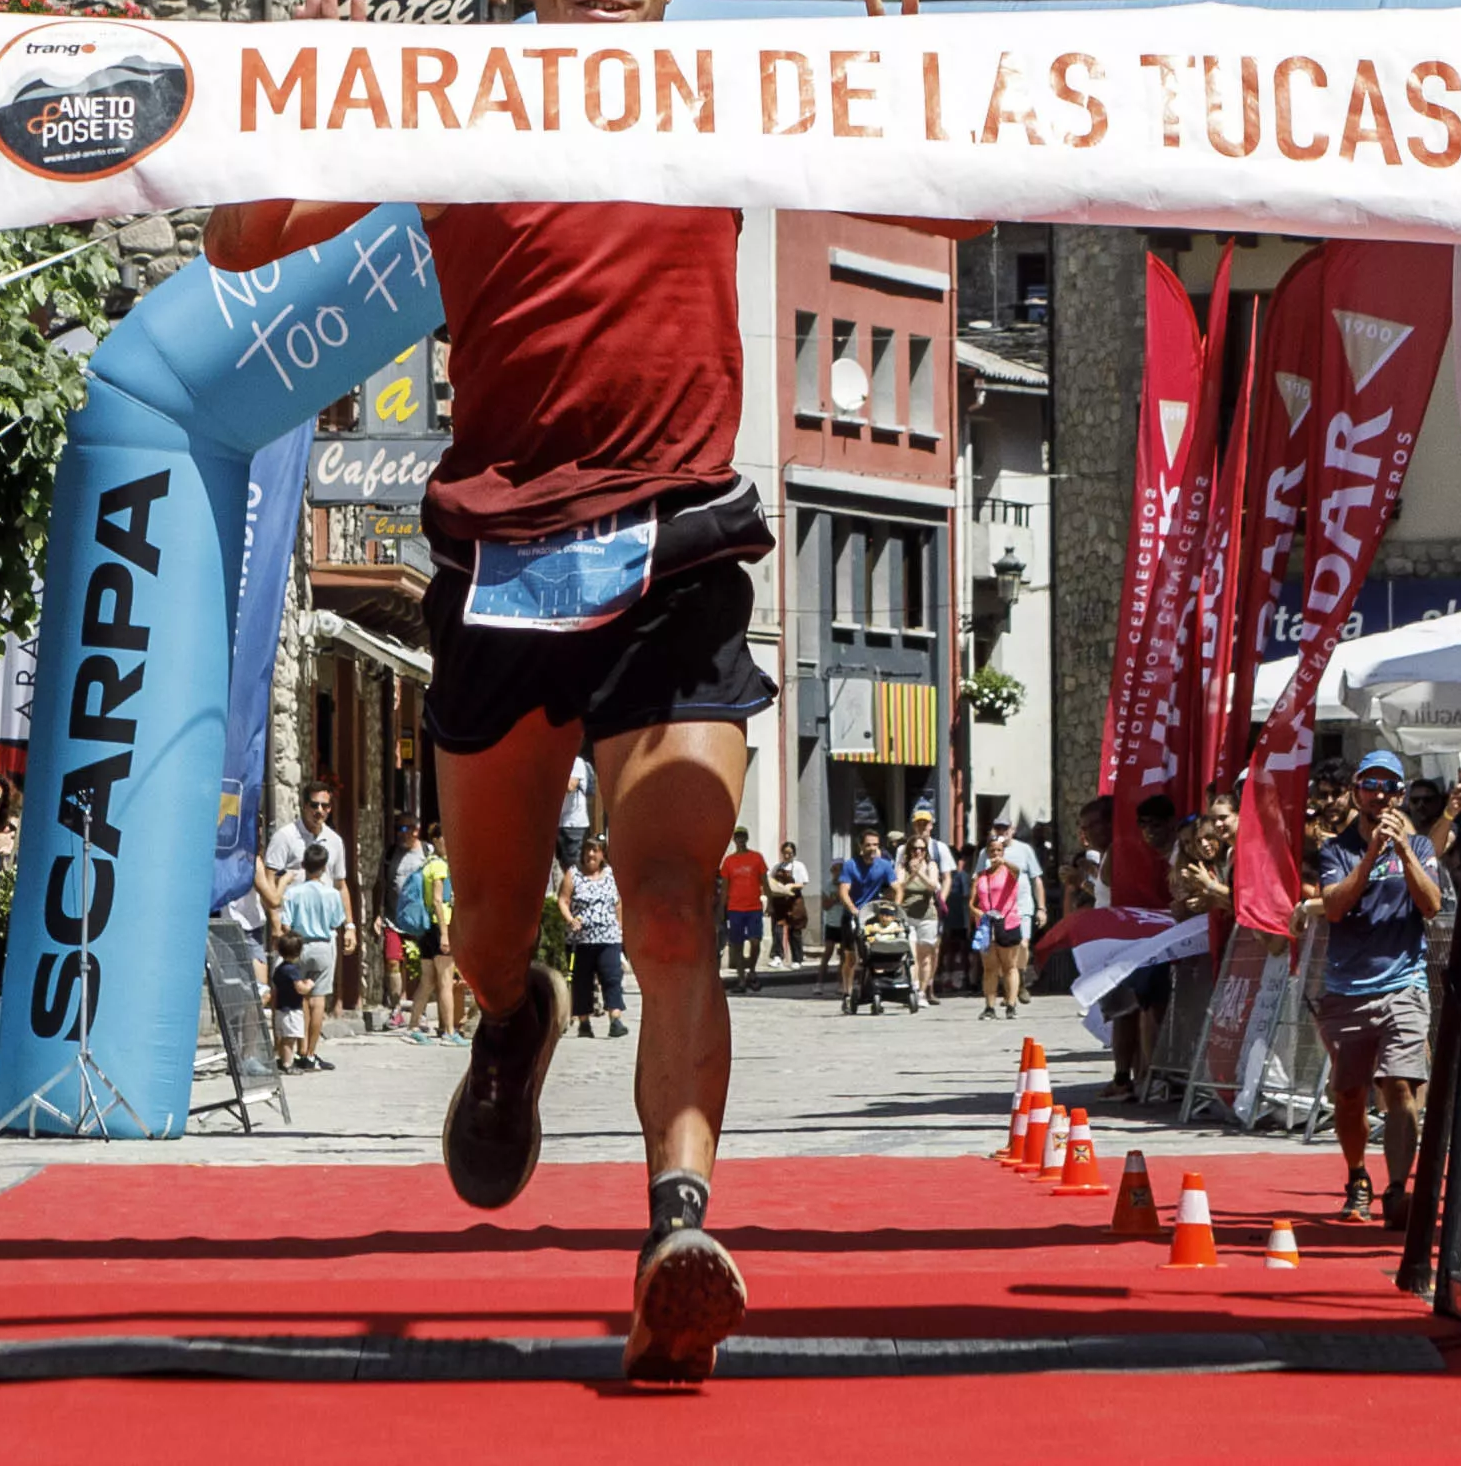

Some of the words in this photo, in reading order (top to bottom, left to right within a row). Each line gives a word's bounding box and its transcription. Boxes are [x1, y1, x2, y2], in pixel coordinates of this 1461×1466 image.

[60, 96, 135, 119] ANETO
[240, 46, 715, 133] MARATON
[759, 50, 884, 138] DE
[923, 51, 1108, 148] LAS
[42, 119, 134, 148] POSETS
[31, 468, 171, 1042] SCARPA
